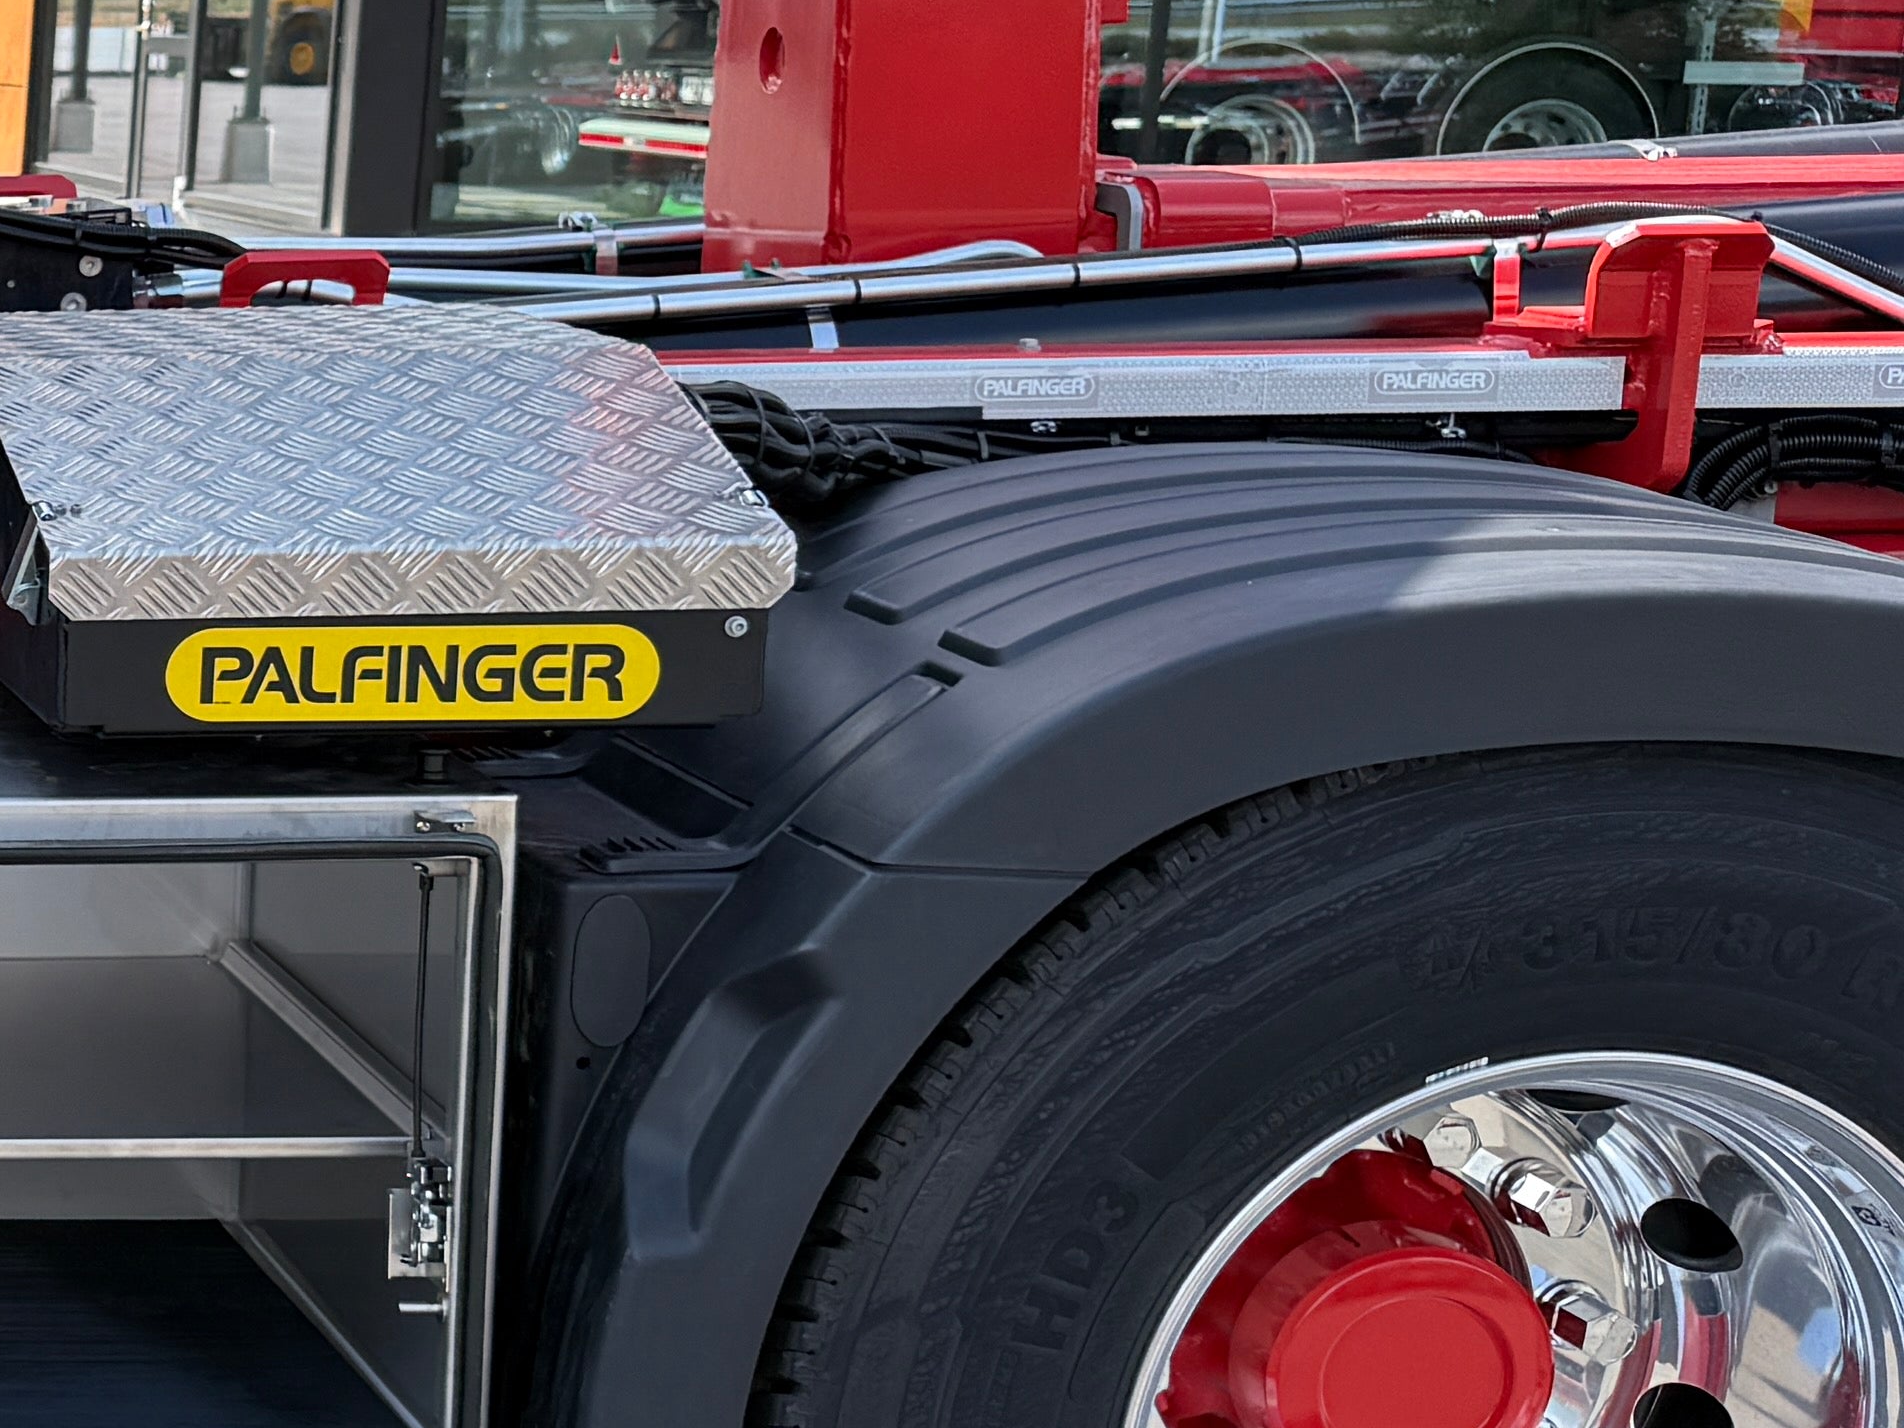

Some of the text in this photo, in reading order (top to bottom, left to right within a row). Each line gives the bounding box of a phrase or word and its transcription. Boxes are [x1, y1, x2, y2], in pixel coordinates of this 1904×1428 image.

[982, 376, 1089, 400] PALFINGER
[1381, 369, 1486, 392] PALFINGER
[199, 643, 625, 706] PALFINGER
[1523, 906, 1828, 980] 315/80
[1010, 1179, 1140, 1350] HD3
